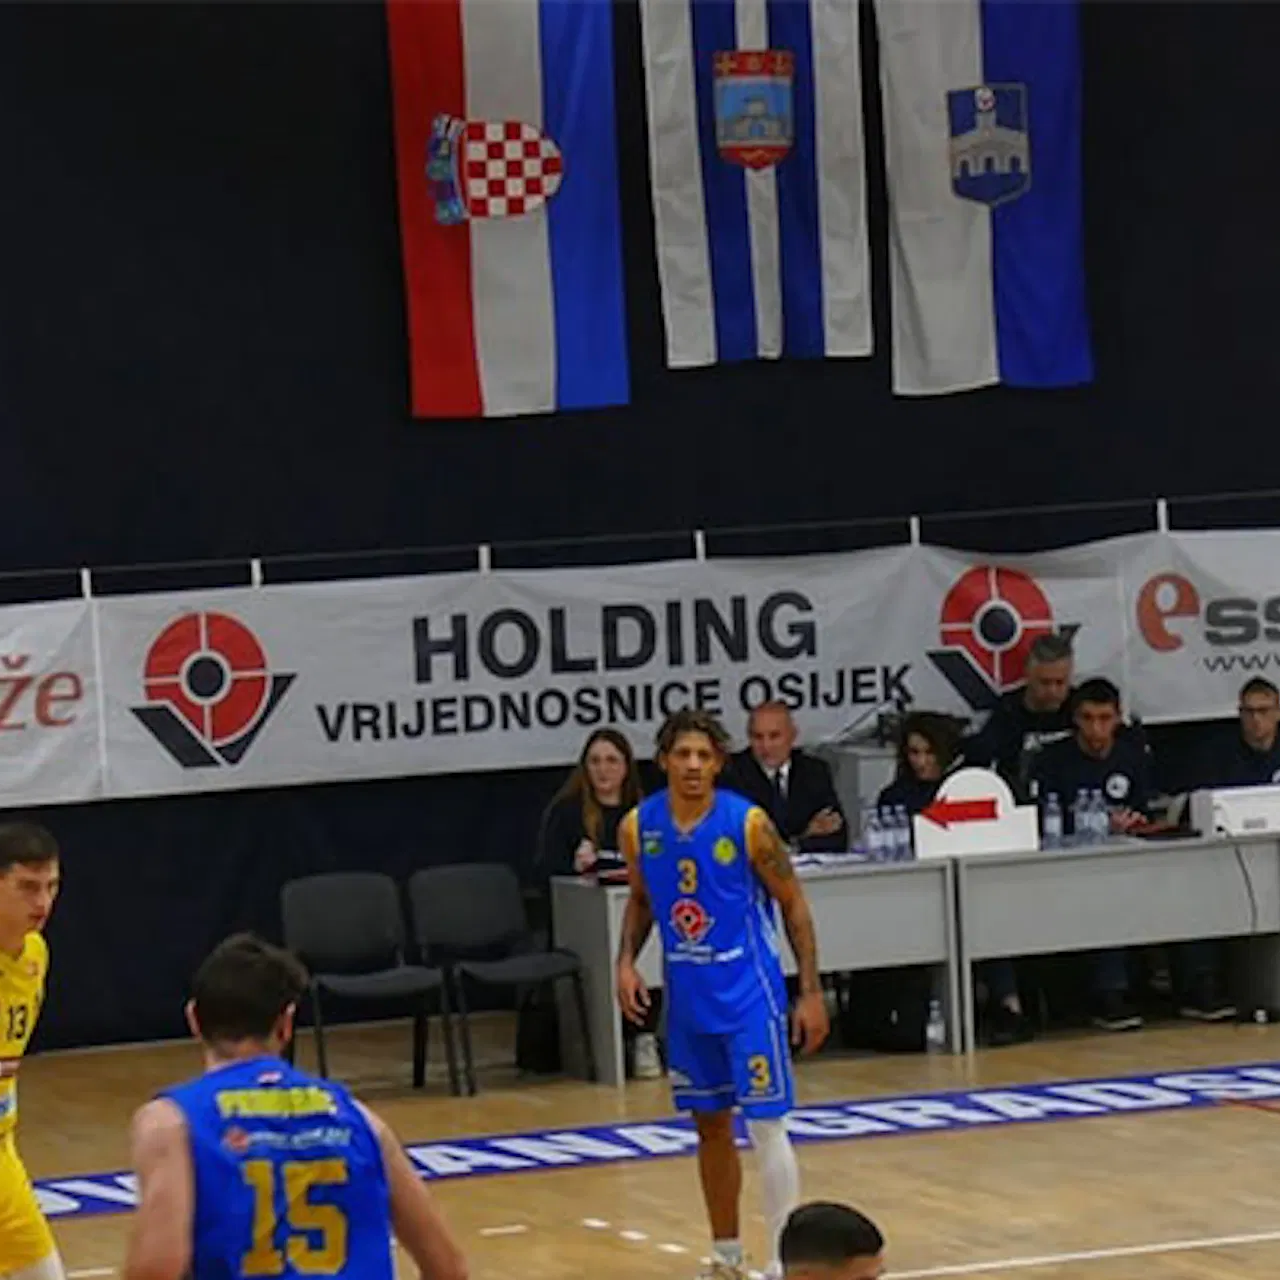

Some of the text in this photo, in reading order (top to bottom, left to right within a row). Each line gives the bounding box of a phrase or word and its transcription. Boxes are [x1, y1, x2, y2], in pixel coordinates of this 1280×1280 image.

[412, 591, 818, 684] HOLDING
[317, 664, 915, 744] VRIJEDNOSNICE OSIJEK
[677, 858, 698, 894] 3
[7, 1003, 28, 1041] 13
[748, 1054, 771, 1089] 3
[239, 1157, 349, 1277] 15
